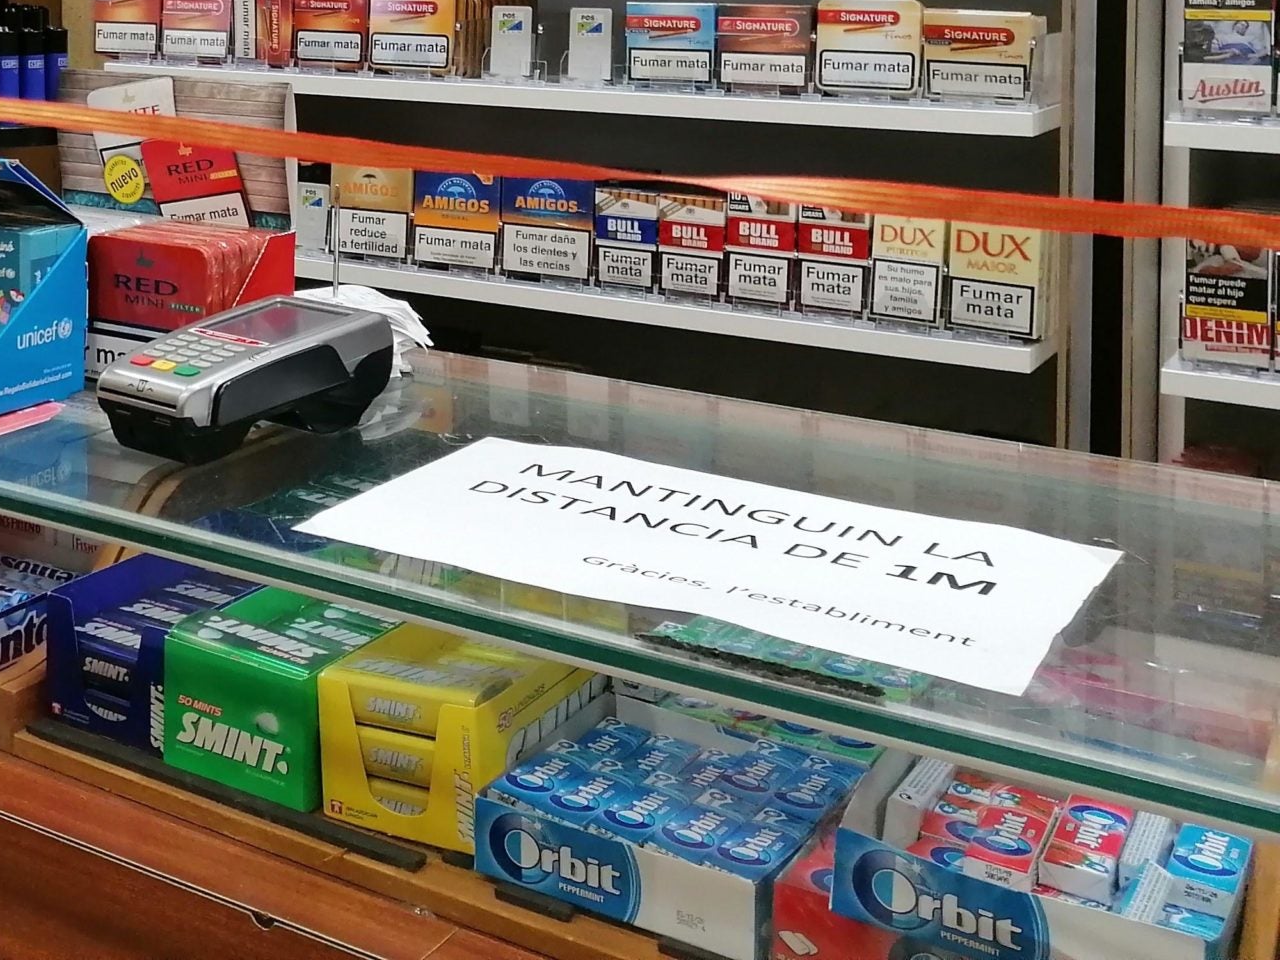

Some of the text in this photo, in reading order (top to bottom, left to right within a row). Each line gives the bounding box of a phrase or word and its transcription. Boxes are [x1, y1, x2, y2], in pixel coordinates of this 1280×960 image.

[97, 30, 155, 41] Fumar mata
[165, 35, 225, 47] Fumar mata
[374, 40, 446, 53] Fumar mata
[1192, 78, 1261, 101] Austin
[168, 159, 214, 175] RED
[423, 195, 489, 213] AMIGOS
[516, 196, 577, 212] AMIGOS
[352, 213, 386, 225] Fumar
[608, 219, 642, 234] BULL
[672, 224, 708, 240] BULL
[812, 229, 853, 247] BULL
[881, 225, 935, 248] DUX
[350, 240, 398, 254] fertilidad
[956, 230, 1031, 261] DUX
[603, 251, 648, 267] Fumar
[667, 258, 714, 274] Fumar
[607, 265, 642, 278] mata
[806, 267, 858, 284] Fumar
[1190, 275, 1246, 289] Fumar puede
[115, 274, 178, 296] RED
[960, 285, 1023, 305] Fumar
[966, 303, 1014, 318] mata
[17, 321, 58, 350] unicef
[1184, 317, 1269, 343] DENIM
[519, 463, 994, 568] MANTINGUIN LA
[468, 480, 998, 596] DISTANCIA DE 1M
[582, 556, 711, 591] Gràcies,
[178, 695, 222, 717] 50 MINTS
[526, 757, 570, 787] Orbit
[987, 811, 1029, 851] Orbit
[1075, 810, 1117, 849] Orbit
[1191, 829, 1232, 873] Orbit
[504, 829, 621, 897] Orbit
[558, 882, 606, 904] PEPPERMINT
[872, 869, 1022, 951] Orbit
[940, 930, 1001, 957] PEPPERMINT
